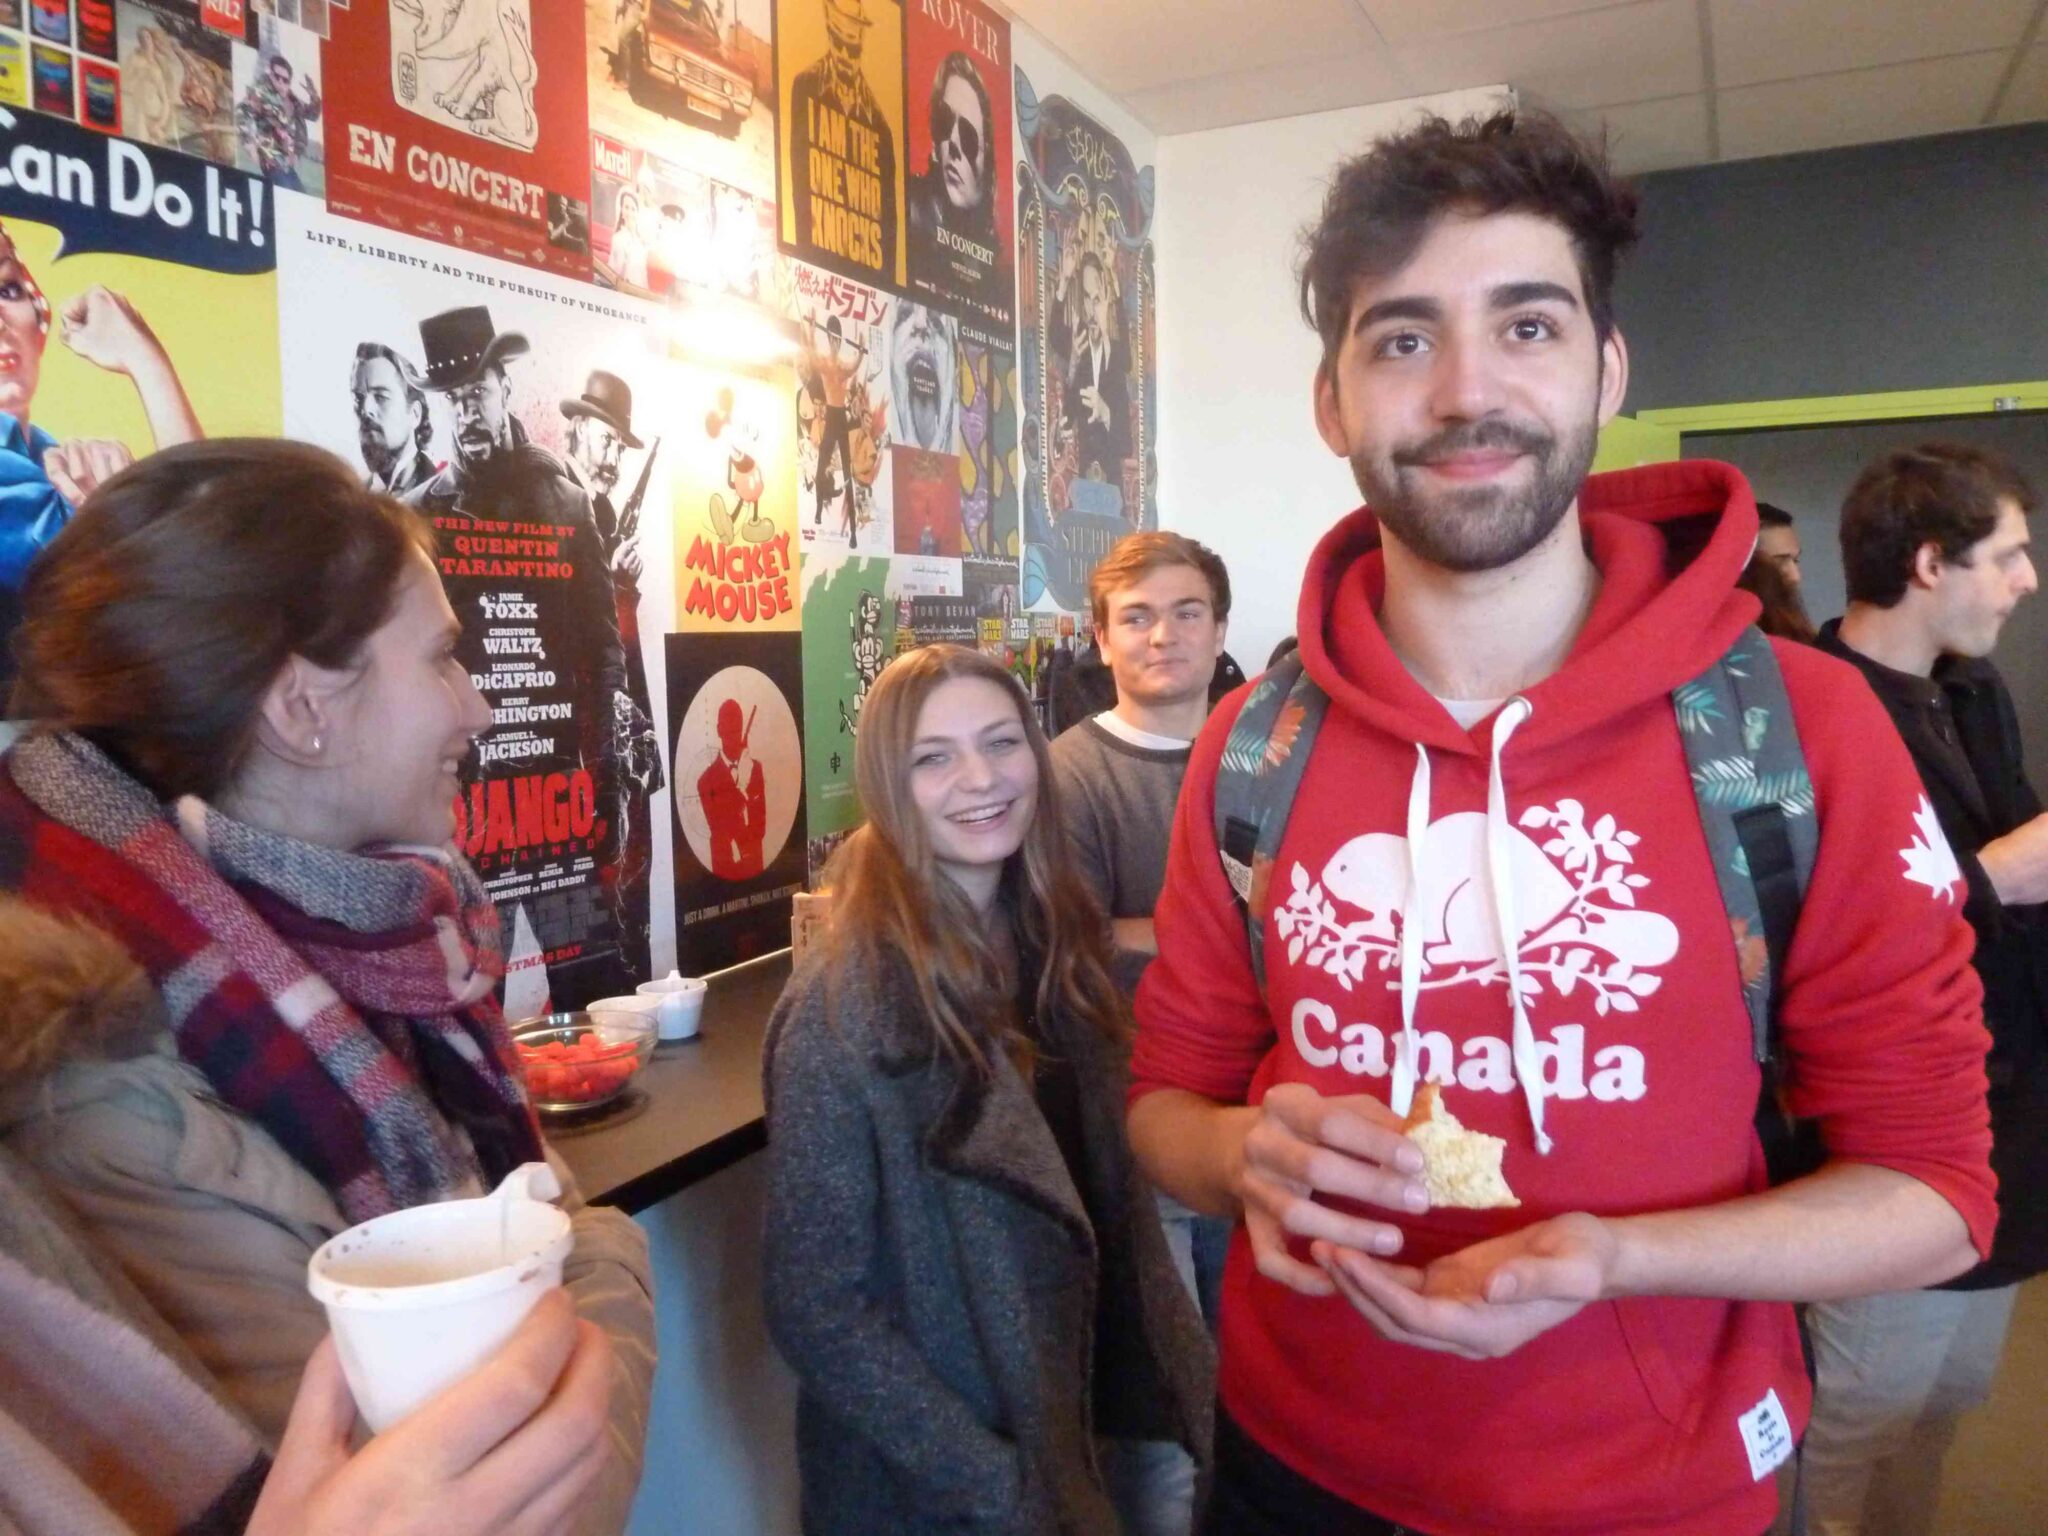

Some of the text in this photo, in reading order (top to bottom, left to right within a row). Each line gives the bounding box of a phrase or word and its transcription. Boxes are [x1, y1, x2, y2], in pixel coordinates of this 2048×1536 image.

[808, 96, 880, 176] I AM THE
[348, 123, 544, 221] EN CONCERT
[108, 137, 193, 227] Do
[206, 165, 265, 247] It!
[809, 147, 881, 221] ONE WHO
[811, 195, 883, 271] KNOCKS
[936, 226, 994, 266] EN CONCERT
[306, 230, 648, 324] LIFE, LIBERTY AND THE PURSUIT OF VENGEANCE
[961, 326, 1013, 352] CLAUDE VIALLAT
[434, 517, 576, 537] THE NEW FILM BY
[455, 535, 559, 557] QUENTIN
[685, 529, 790, 584] MICKEY
[439, 557, 574, 579] TARANTINO
[498, 593, 524, 602] JAMIE
[685, 576, 793, 623] MOUSE
[484, 603, 539, 619] FOXX
[914, 605, 976, 617] TONY BEVAN
[488, 628, 536, 637] CHRISTOPH
[1010, 618, 1029, 629] STAR
[1011, 629, 1029, 640] WARS
[482, 637, 544, 655] WALTZ
[491, 662, 536, 672] LEONARDO
[470, 671, 557, 690] DiCAPRIO
[491, 703, 572, 724] HINGTON
[496, 731, 529, 743] SAMUEL
[480, 738, 555, 766] JACKSON
[480, 838, 595, 868] CHAINED
[483, 873, 533, 888] CHRISTOPHER
[490, 885, 531, 903] JOHNSON
[541, 880, 557, 891] BIG
[558, 874, 586, 888] DADDY
[684, 910, 697, 925] JUST
[503, 944, 583, 973] STMAS DAY
[1290, 998, 1648, 1101] Canada
